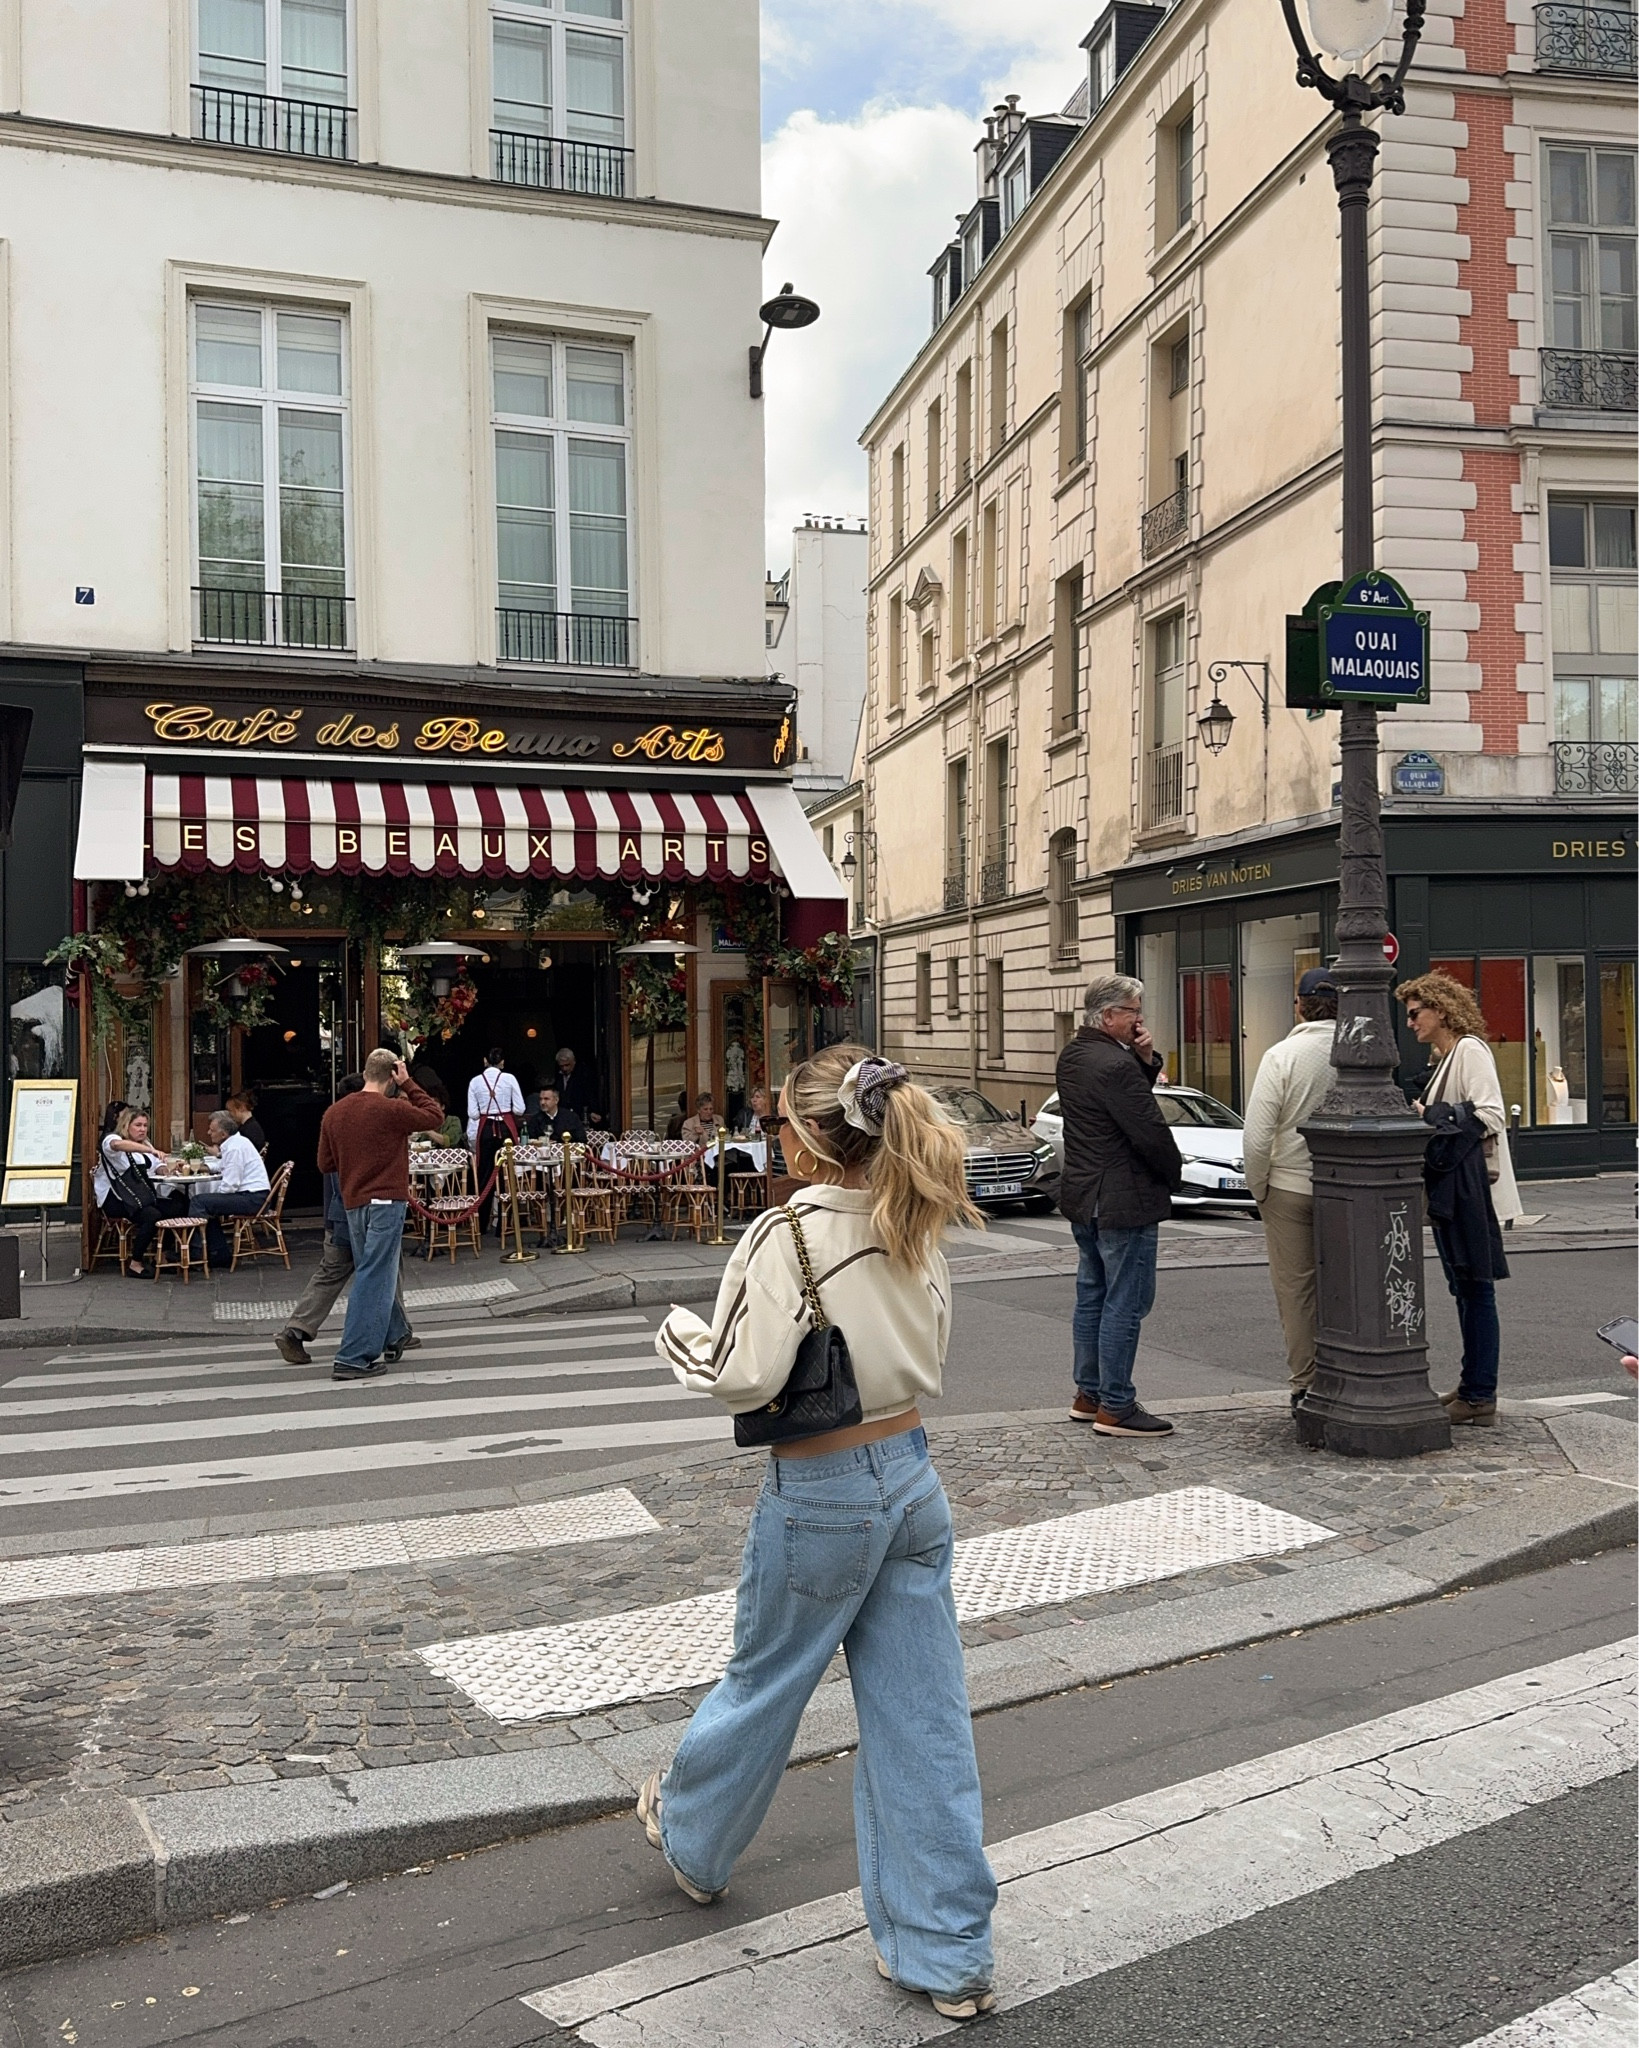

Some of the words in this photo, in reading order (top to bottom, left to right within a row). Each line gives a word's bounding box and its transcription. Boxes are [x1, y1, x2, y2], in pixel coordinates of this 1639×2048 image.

[79, 588, 90, 603] 7
[1355, 631, 1397, 651] QUAI
[1331, 657, 1420, 680] MALAQUAIS
[145, 702, 304, 746] Café
[316, 714, 400, 749] des
[414, 717, 602, 757] Beaux
[612, 725, 725, 762] Arts
[1409, 772, 1428, 780] QUAI
[144, 824, 257, 851] ES
[338, 830, 551, 859] BEAUX
[621, 838, 768, 863] ARTS
[1552, 841, 1626, 857] DRIES
[1172, 876, 1203, 894] DRIES
[1206, 871, 1228, 888] VAN
[1231, 863, 1271, 884] NOTEN
